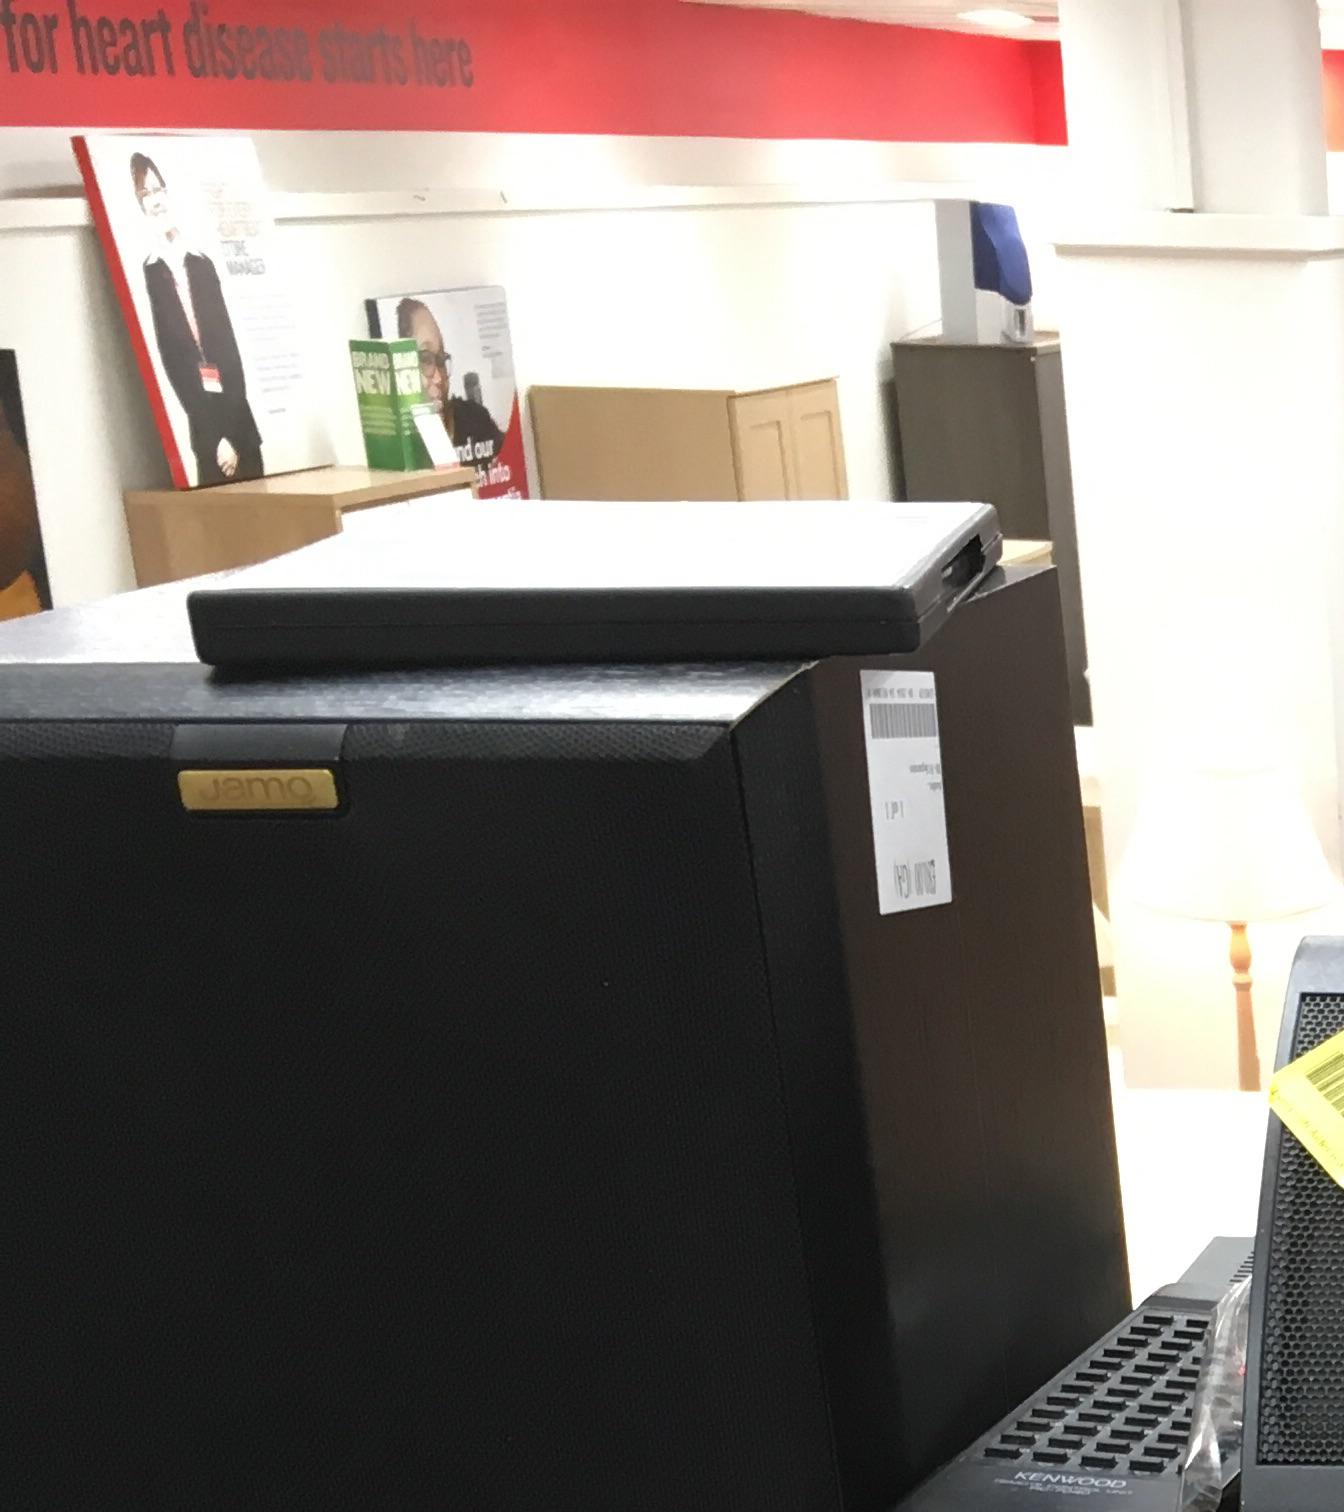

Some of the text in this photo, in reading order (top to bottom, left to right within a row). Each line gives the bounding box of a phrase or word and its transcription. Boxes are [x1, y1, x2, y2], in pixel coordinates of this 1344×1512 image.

[0, 0, 474, 87] for heart disease starts here
[355, 369, 390, 394] NEW
[475, 439, 493, 458] our
[1014, 1472, 1127, 1488] KENWOOD
